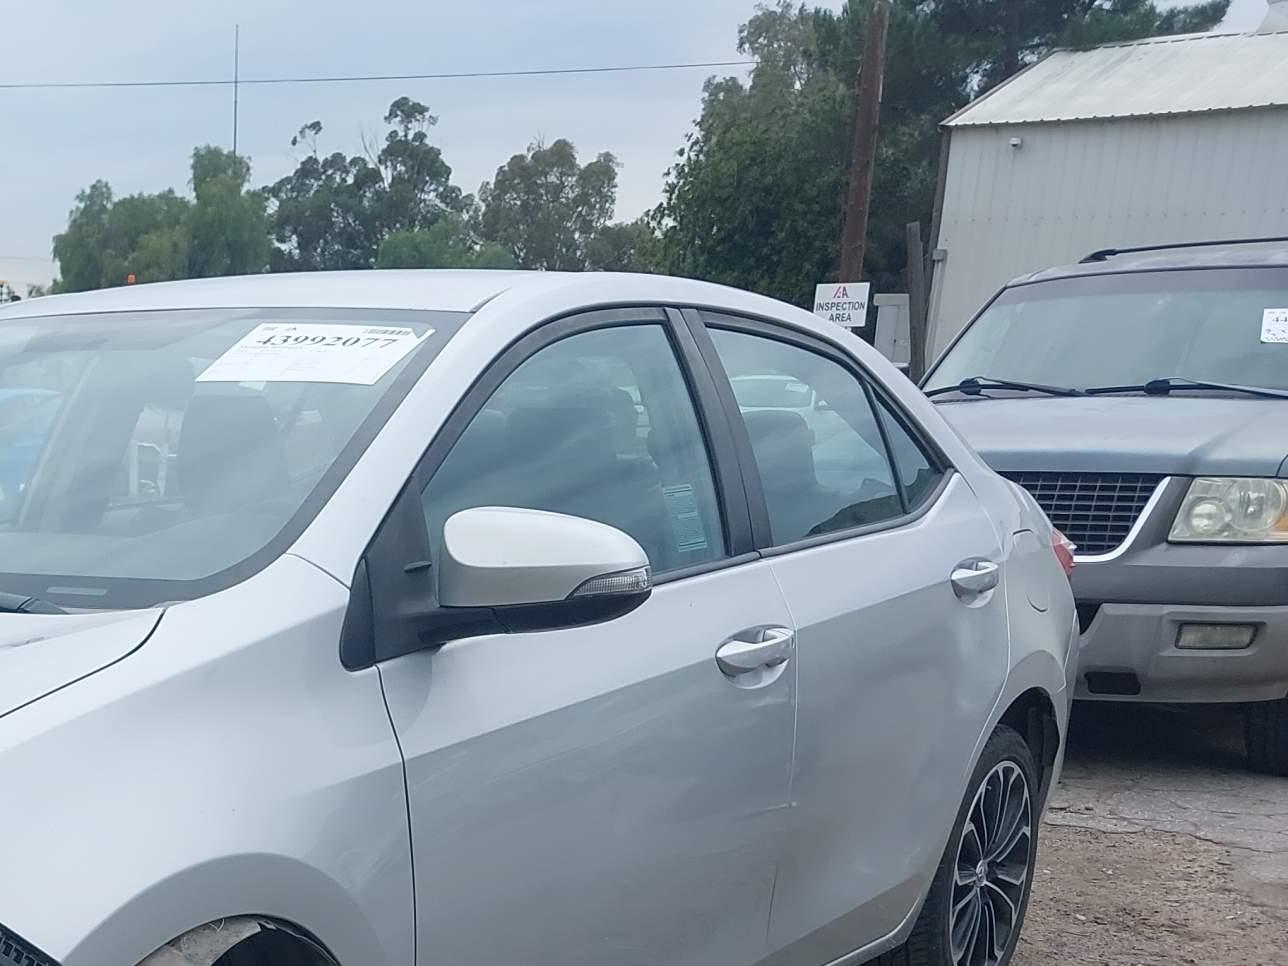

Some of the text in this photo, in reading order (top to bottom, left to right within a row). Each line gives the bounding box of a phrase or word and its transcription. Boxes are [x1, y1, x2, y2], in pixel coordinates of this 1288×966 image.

[816, 301, 865, 311] INSPECTION
[828, 313, 852, 322] AREA
[256, 335, 399, 349] 43992077
